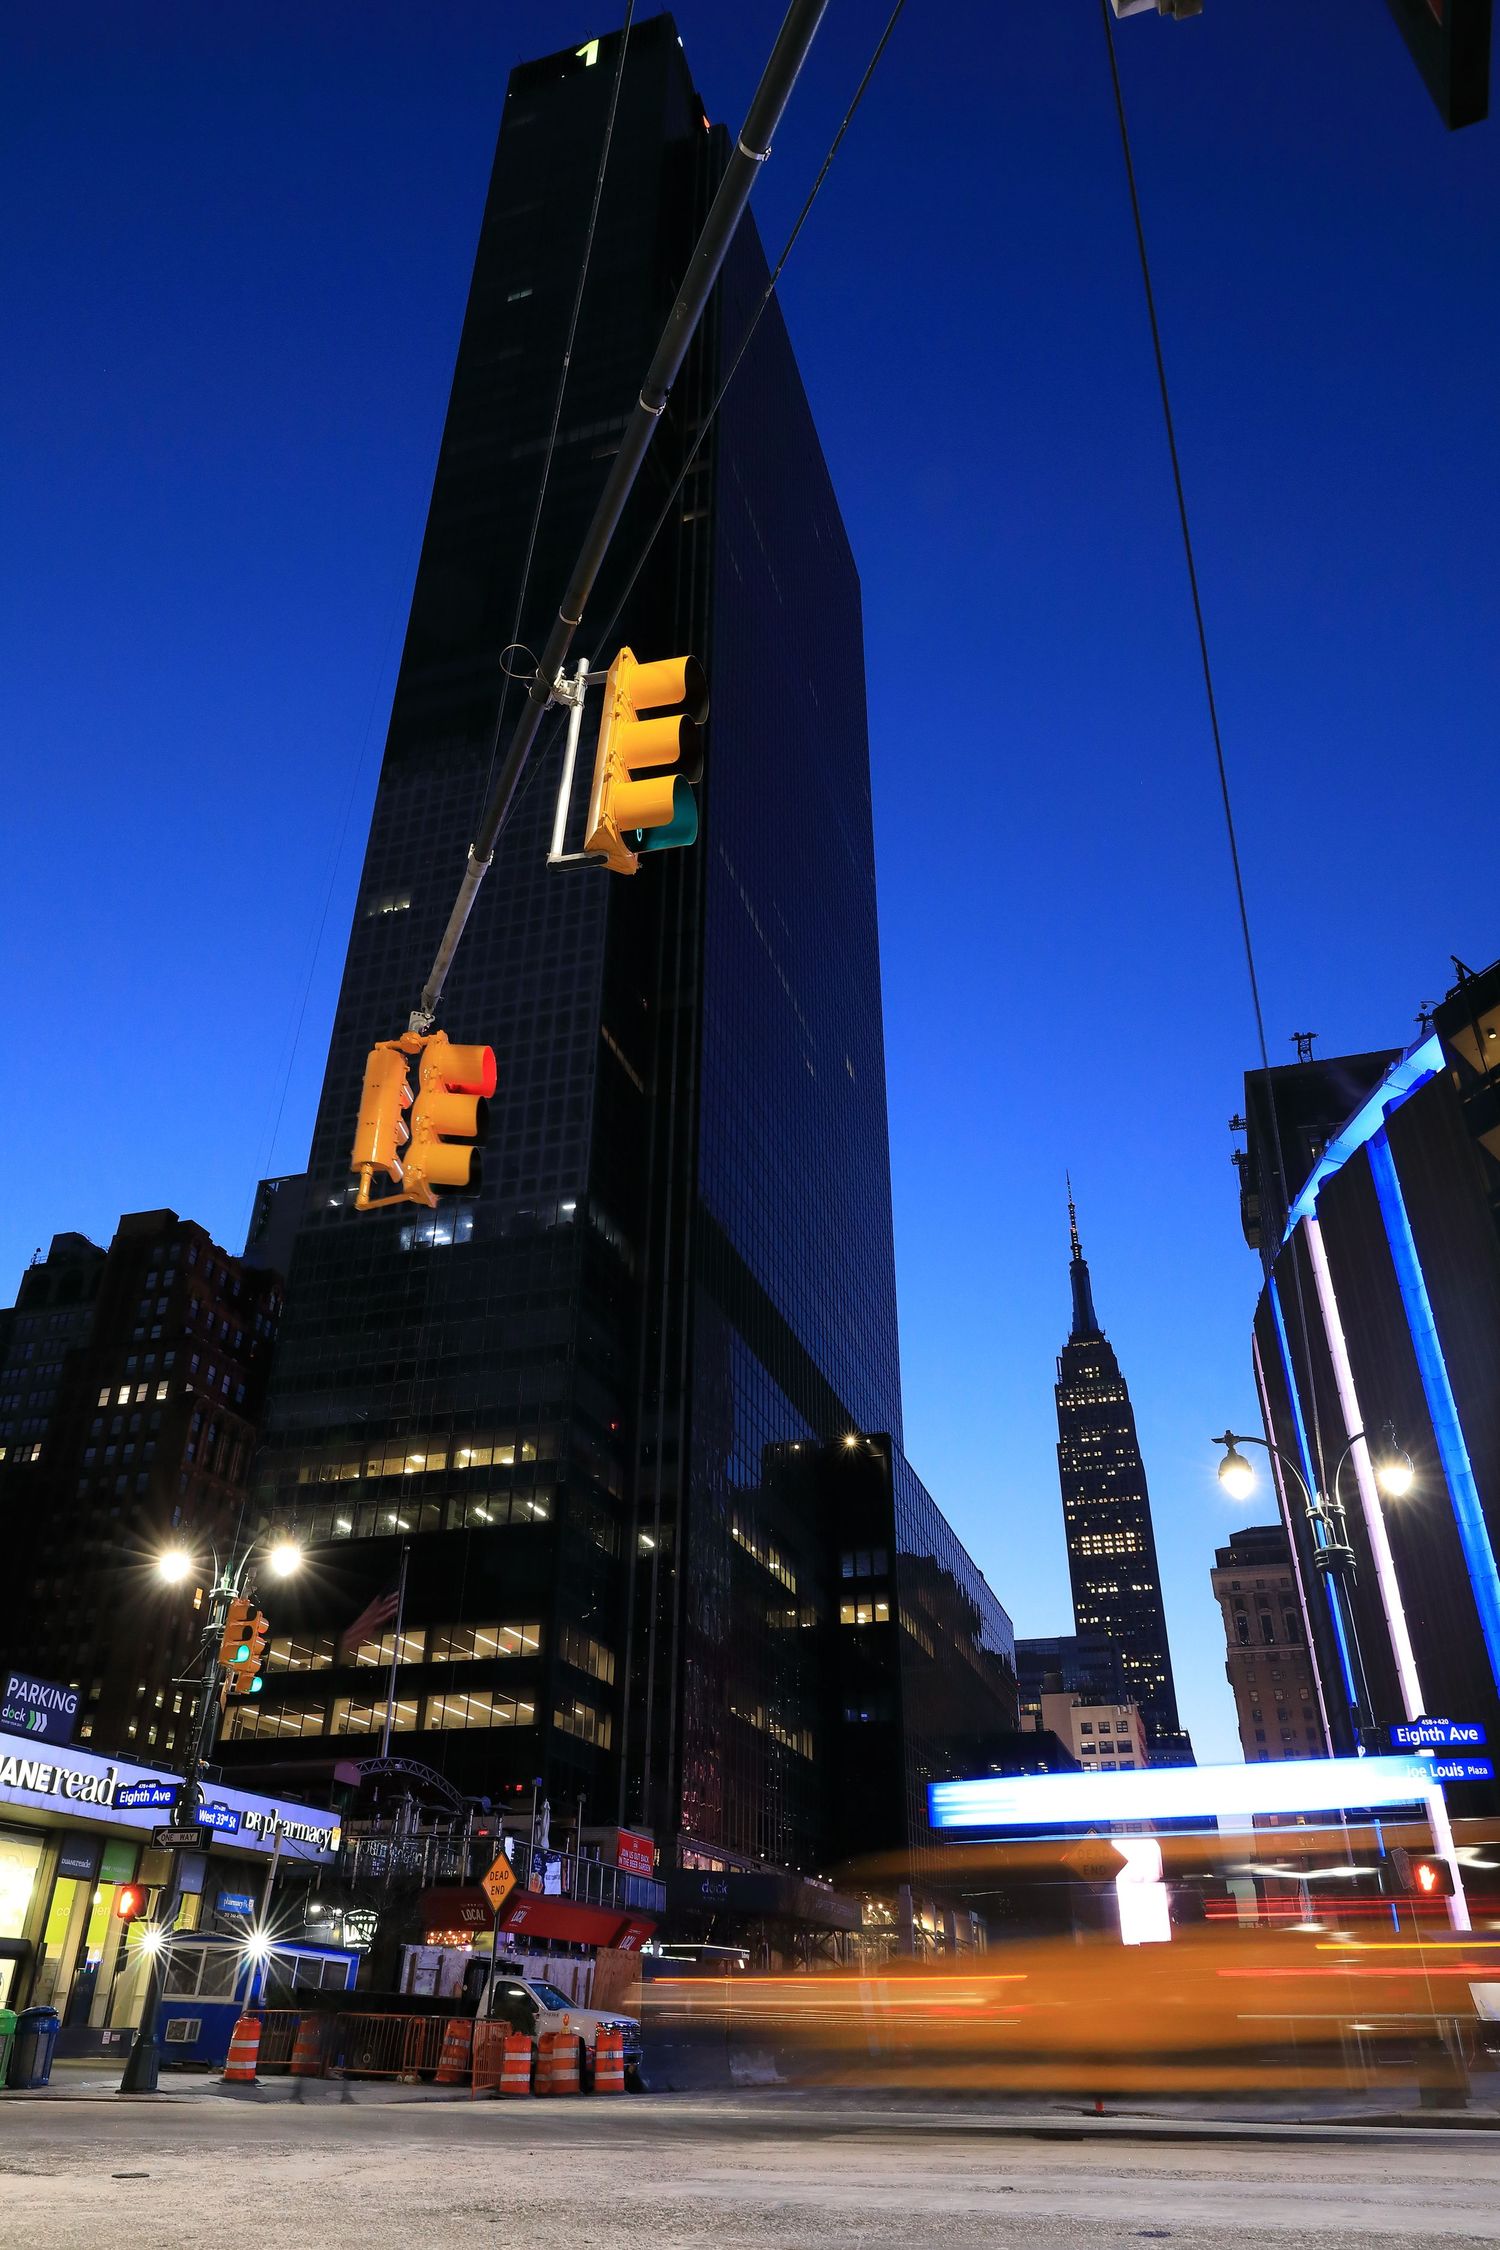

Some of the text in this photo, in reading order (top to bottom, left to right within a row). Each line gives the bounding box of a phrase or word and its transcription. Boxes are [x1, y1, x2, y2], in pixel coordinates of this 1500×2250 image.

[575, 38, 600, 67] 1
[7, 1677, 78, 1714] PARKING
[2, 1704, 26, 1722] dock
[1396, 1727, 1479, 1745] Eighth Ave
[1429, 1762, 1465, 1777] Louis
[1467, 1766, 1488, 1775] Plaza
[0, 1754, 128, 1806] ANEread
[119, 1790, 171, 1806] Eighth Ave
[199, 1809, 236, 1828] West 33rd St
[161, 1832, 194, 1841] ONE WAY
[262, 1808, 332, 1853] pharmacy
[489, 1870, 509, 1881] DEAD
[491, 1885, 505, 1896] END
[461, 1908, 486, 1921] LOCAL
